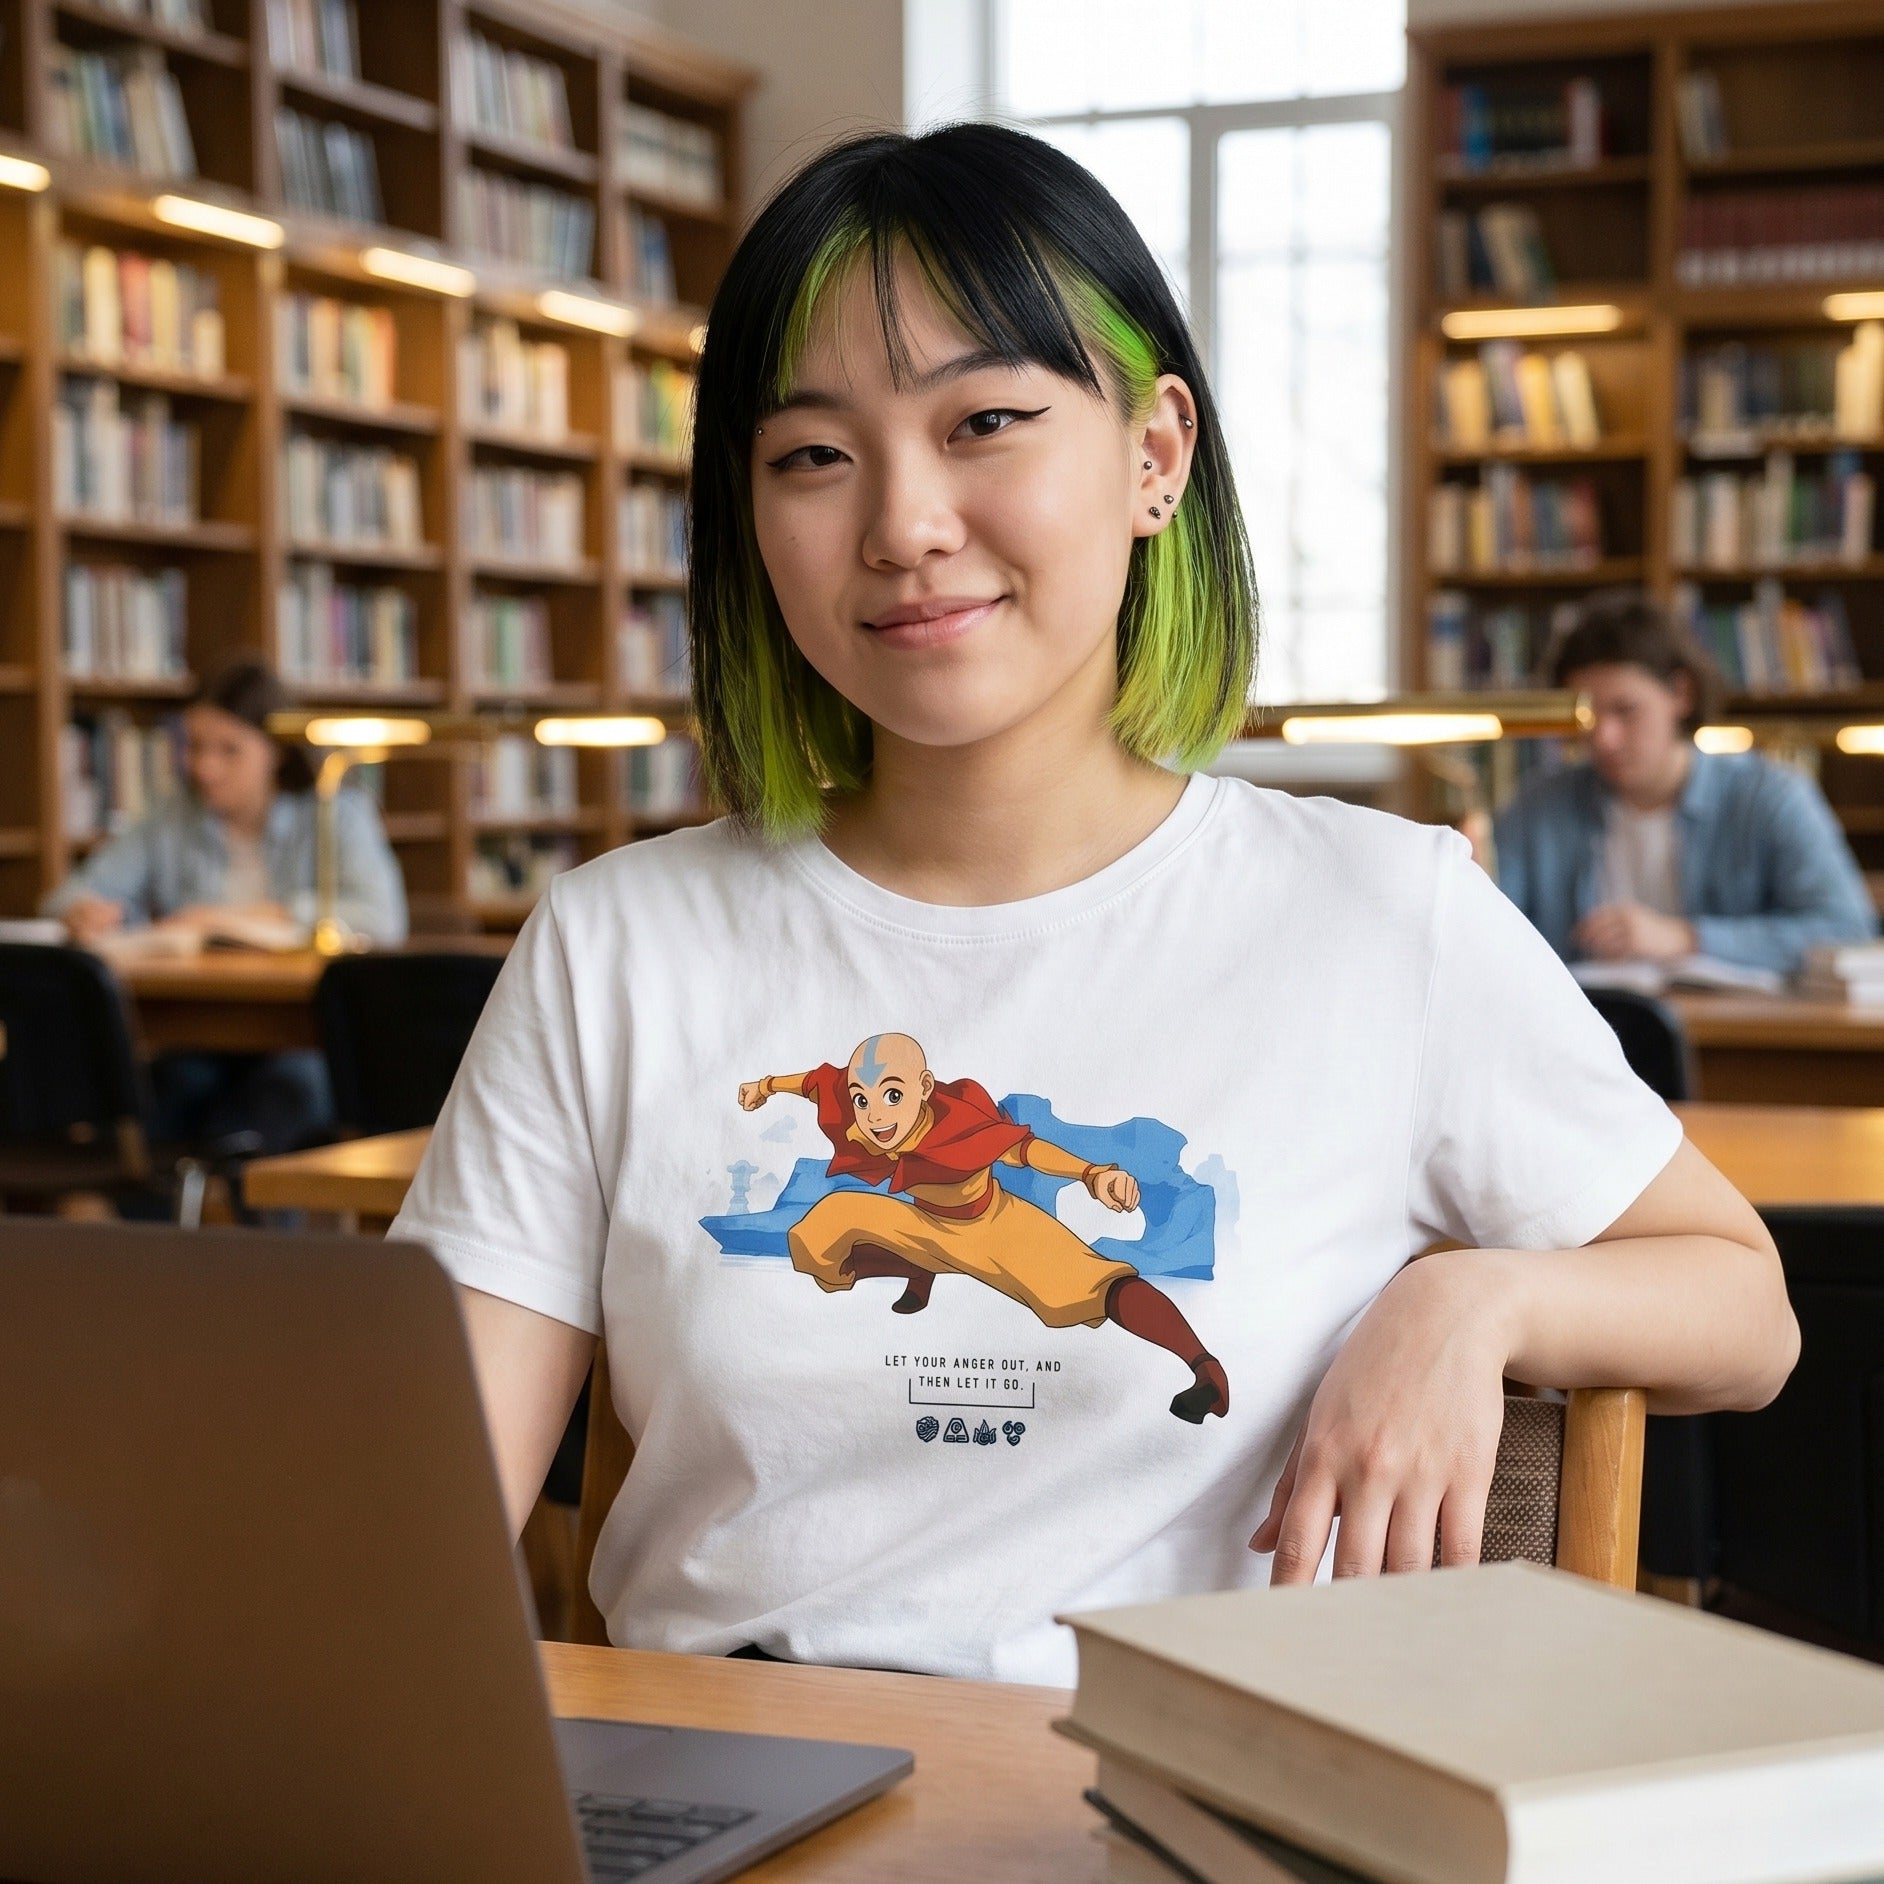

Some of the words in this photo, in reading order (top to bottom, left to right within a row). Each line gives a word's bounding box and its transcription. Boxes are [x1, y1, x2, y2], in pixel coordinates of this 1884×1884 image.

[885, 1355, 907, 1367] LET
[914, 1356, 947, 1368] YOUR
[953, 1358, 995, 1370] ANGER
[1001, 1359, 1029, 1372] OUT,
[1036, 1361, 1061, 1372] AND
[919, 1376, 950, 1388] THEN
[957, 1377, 979, 1389] LET
[985, 1378, 997, 1390] IT
[1003, 1379, 1024, 1390] GO.
